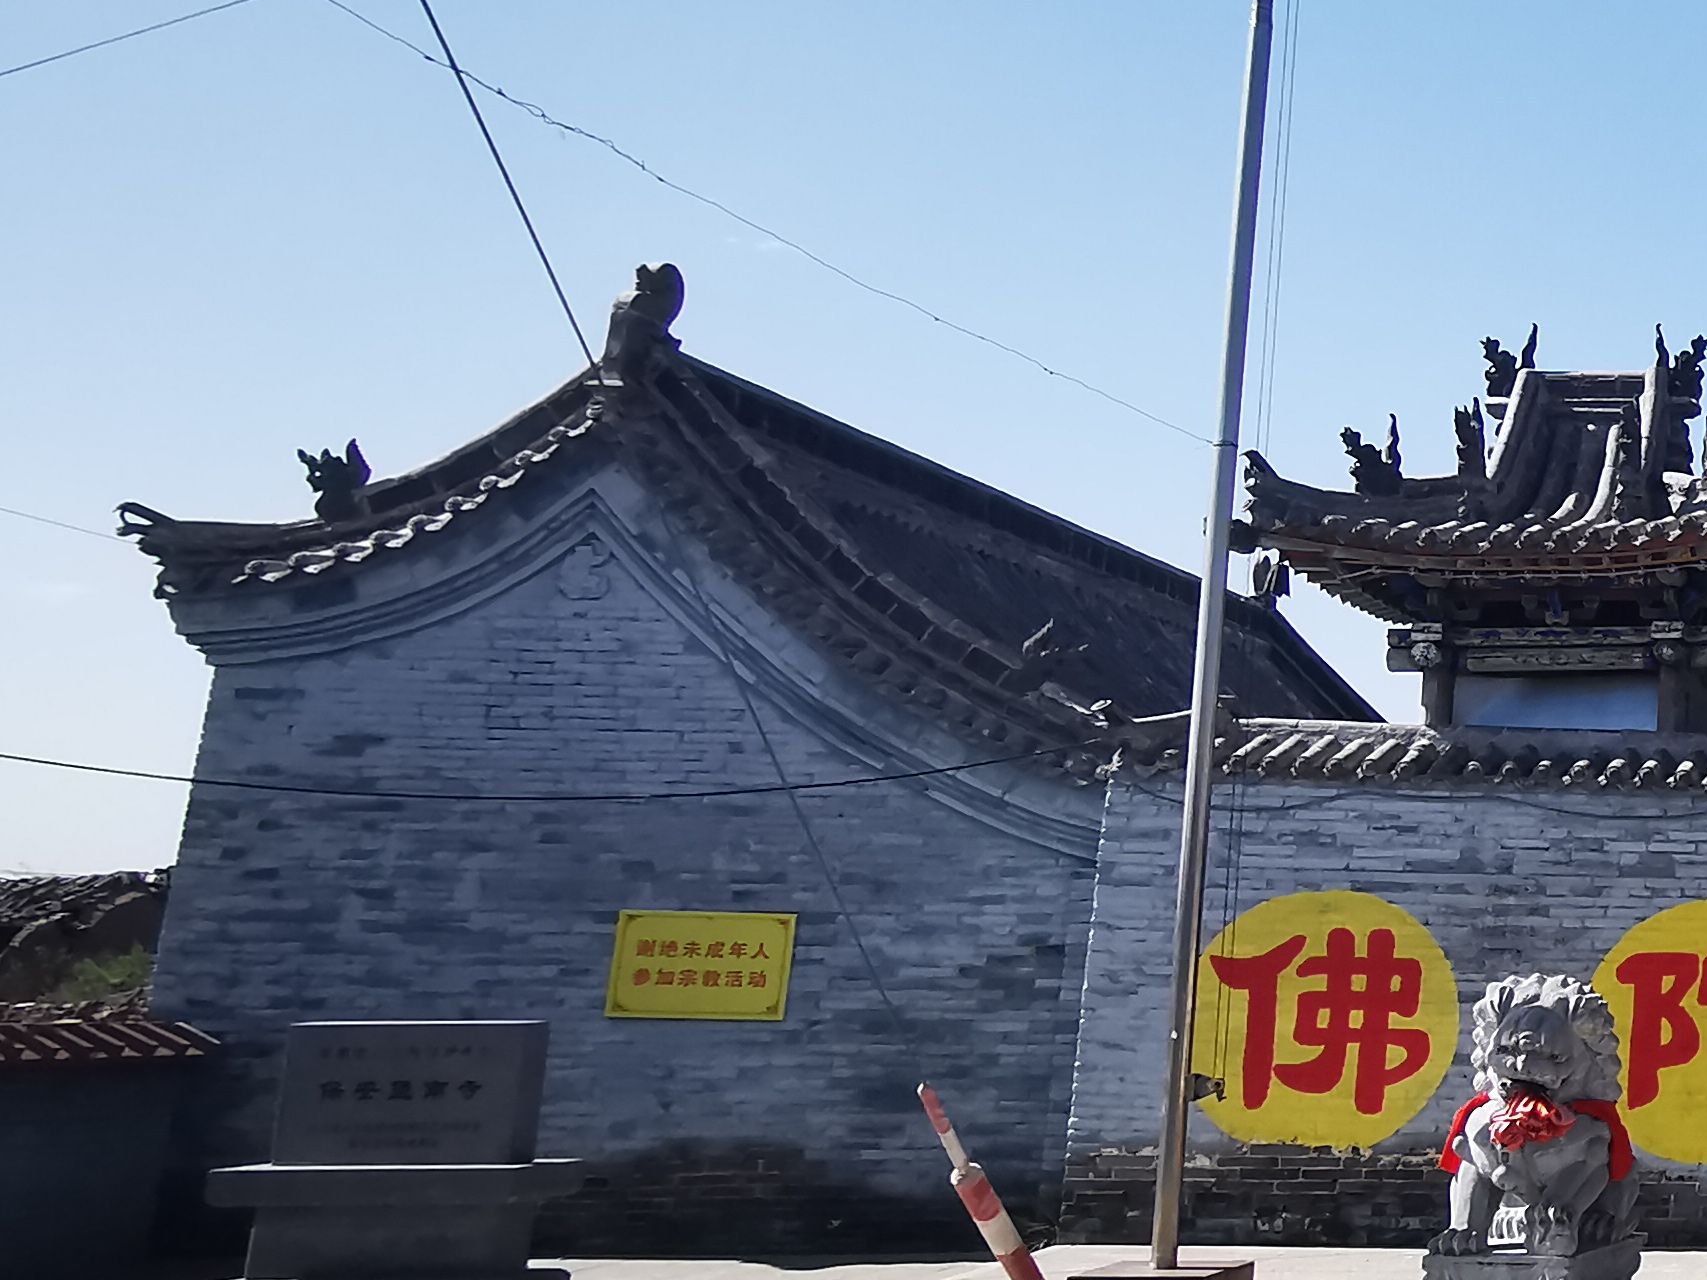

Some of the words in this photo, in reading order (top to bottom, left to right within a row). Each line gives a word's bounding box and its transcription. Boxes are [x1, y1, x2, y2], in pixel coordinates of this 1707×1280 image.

[635, 939, 770, 960] 谢绝未成年人
[631, 968, 767, 988] 参加宗教活动
[1210, 927, 1432, 1115] 佛
